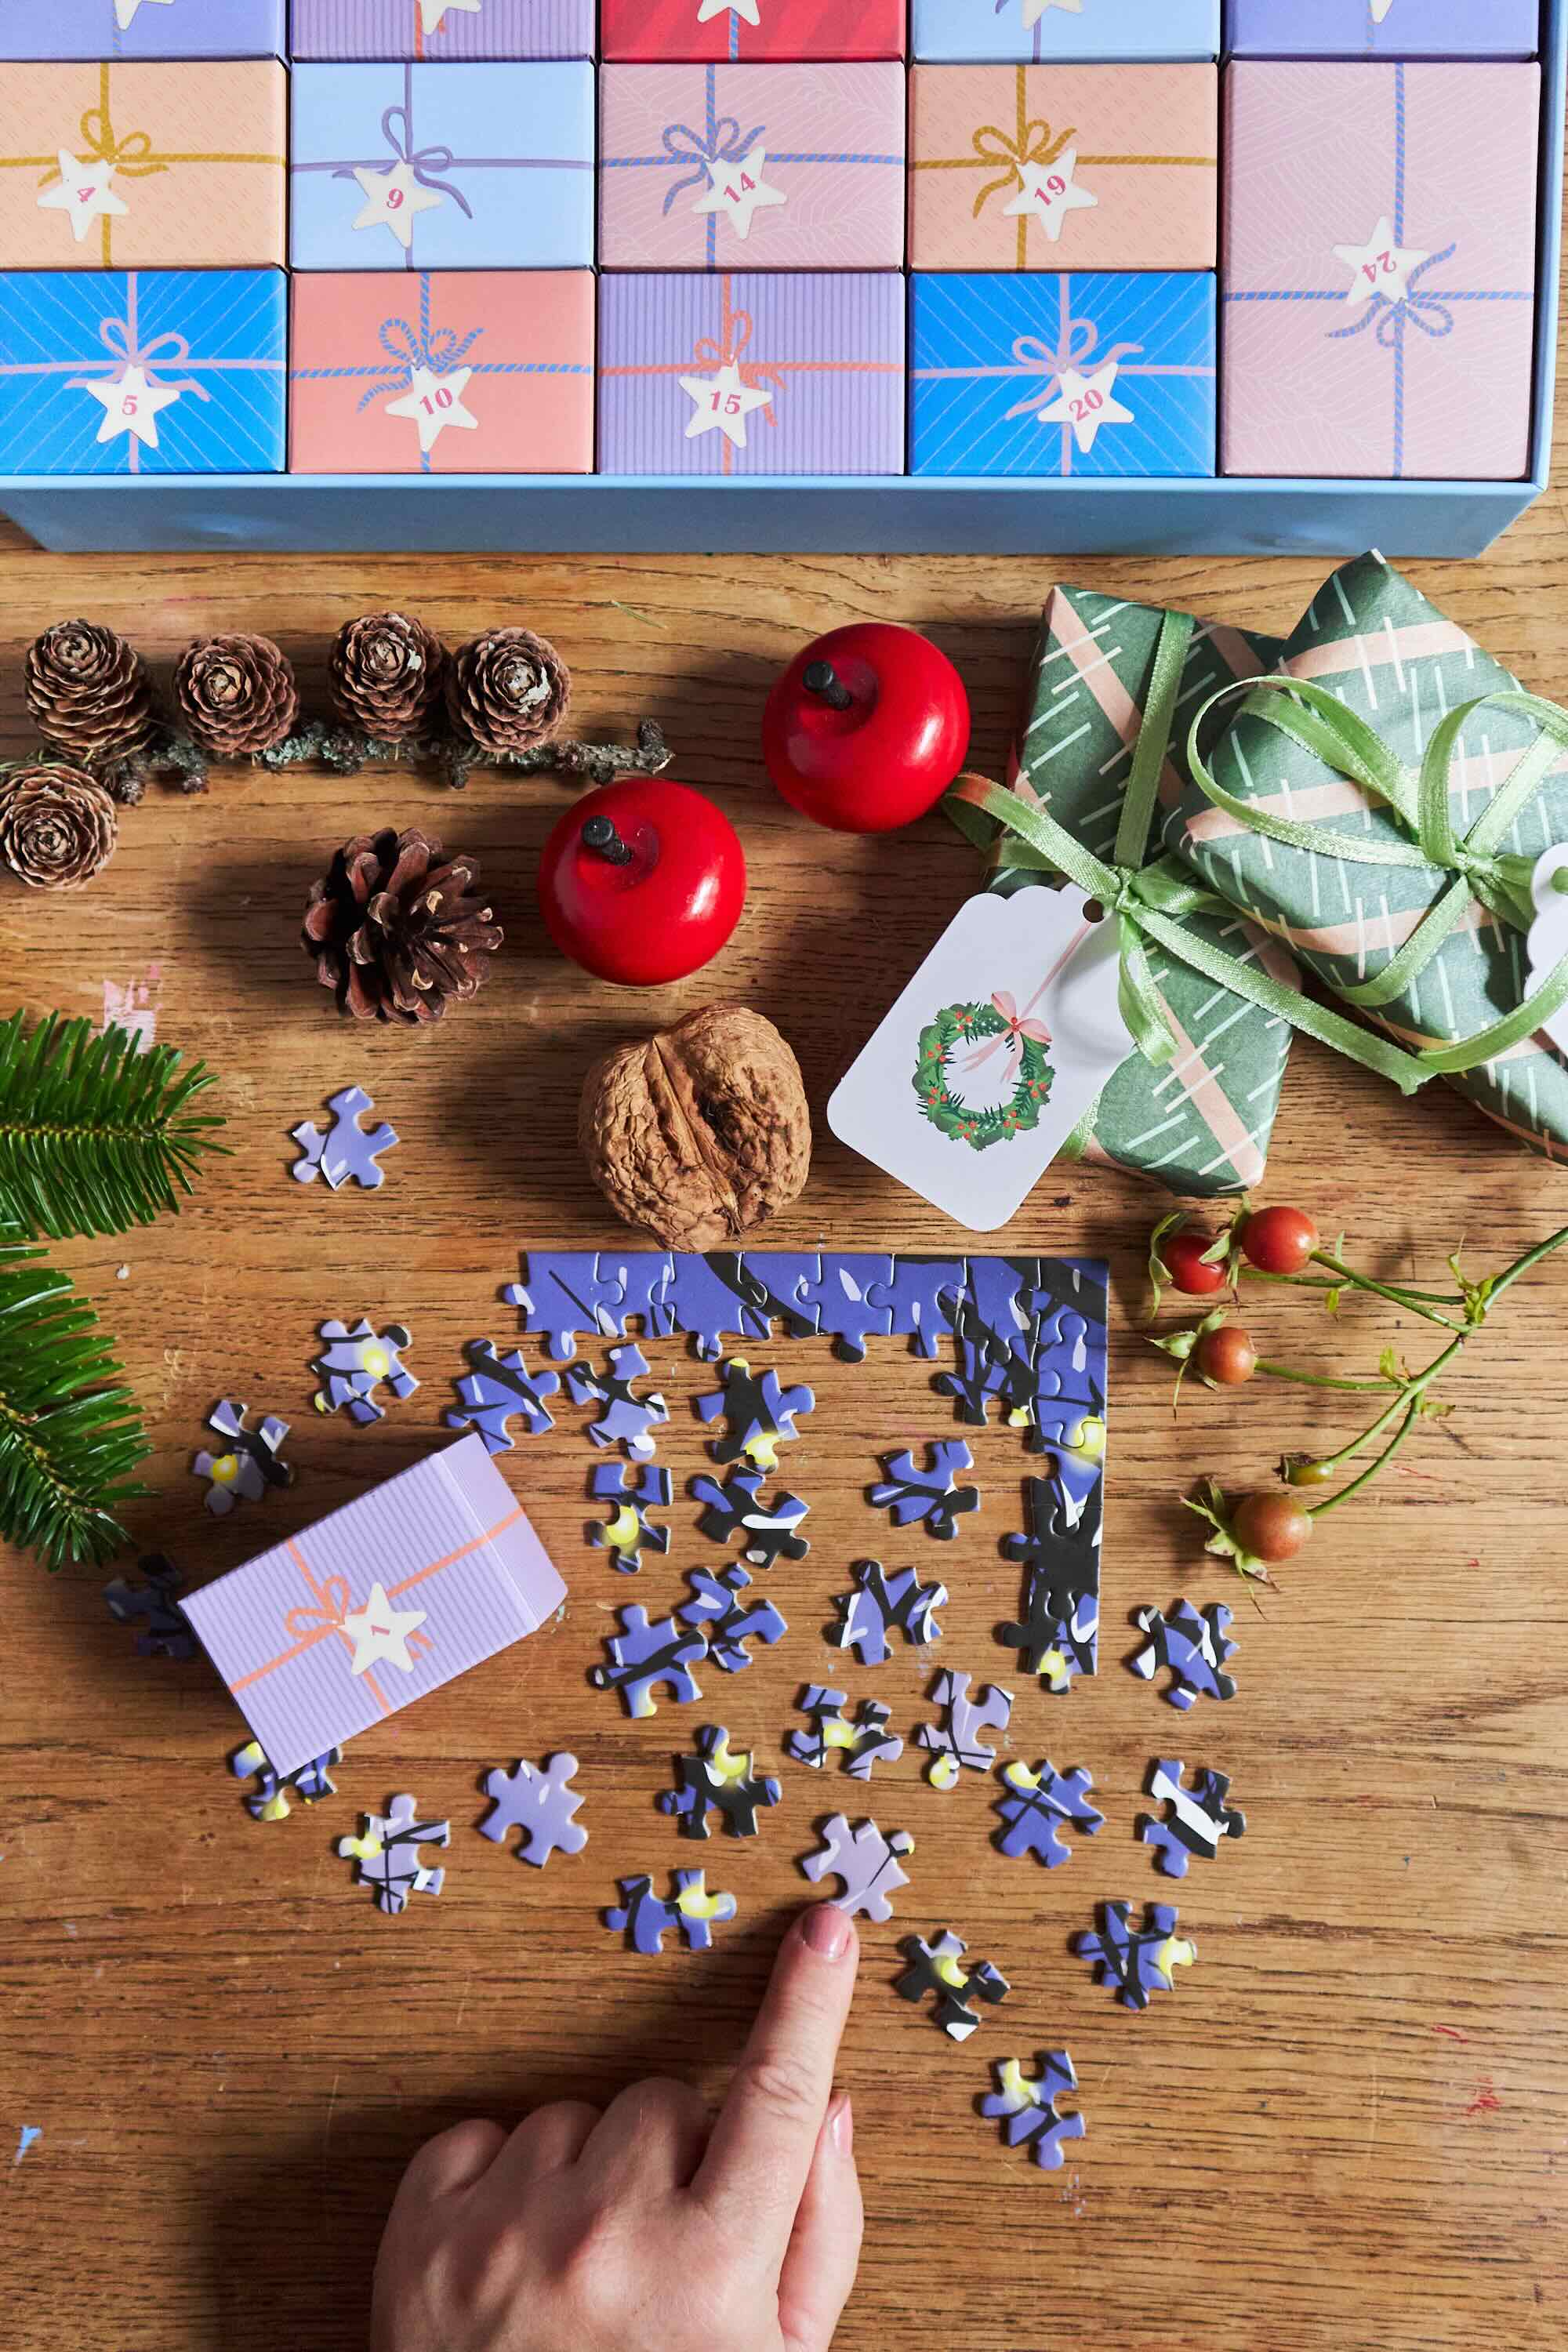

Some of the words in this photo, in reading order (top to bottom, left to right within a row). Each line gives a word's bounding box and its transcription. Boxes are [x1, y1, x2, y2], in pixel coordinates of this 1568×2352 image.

[78, 187, 96, 202] 4
[387, 187, 405, 209] 9
[723, 172, 757, 202] 14
[1034, 175, 1067, 206] 19
[1362, 250, 1397, 282] 24
[122, 394, 139, 416] 5
[419, 387, 453, 415] 10
[710, 390, 741, 416] 15
[1068, 389, 1105, 421] 20
[370, 1624, 390, 1637] 1
